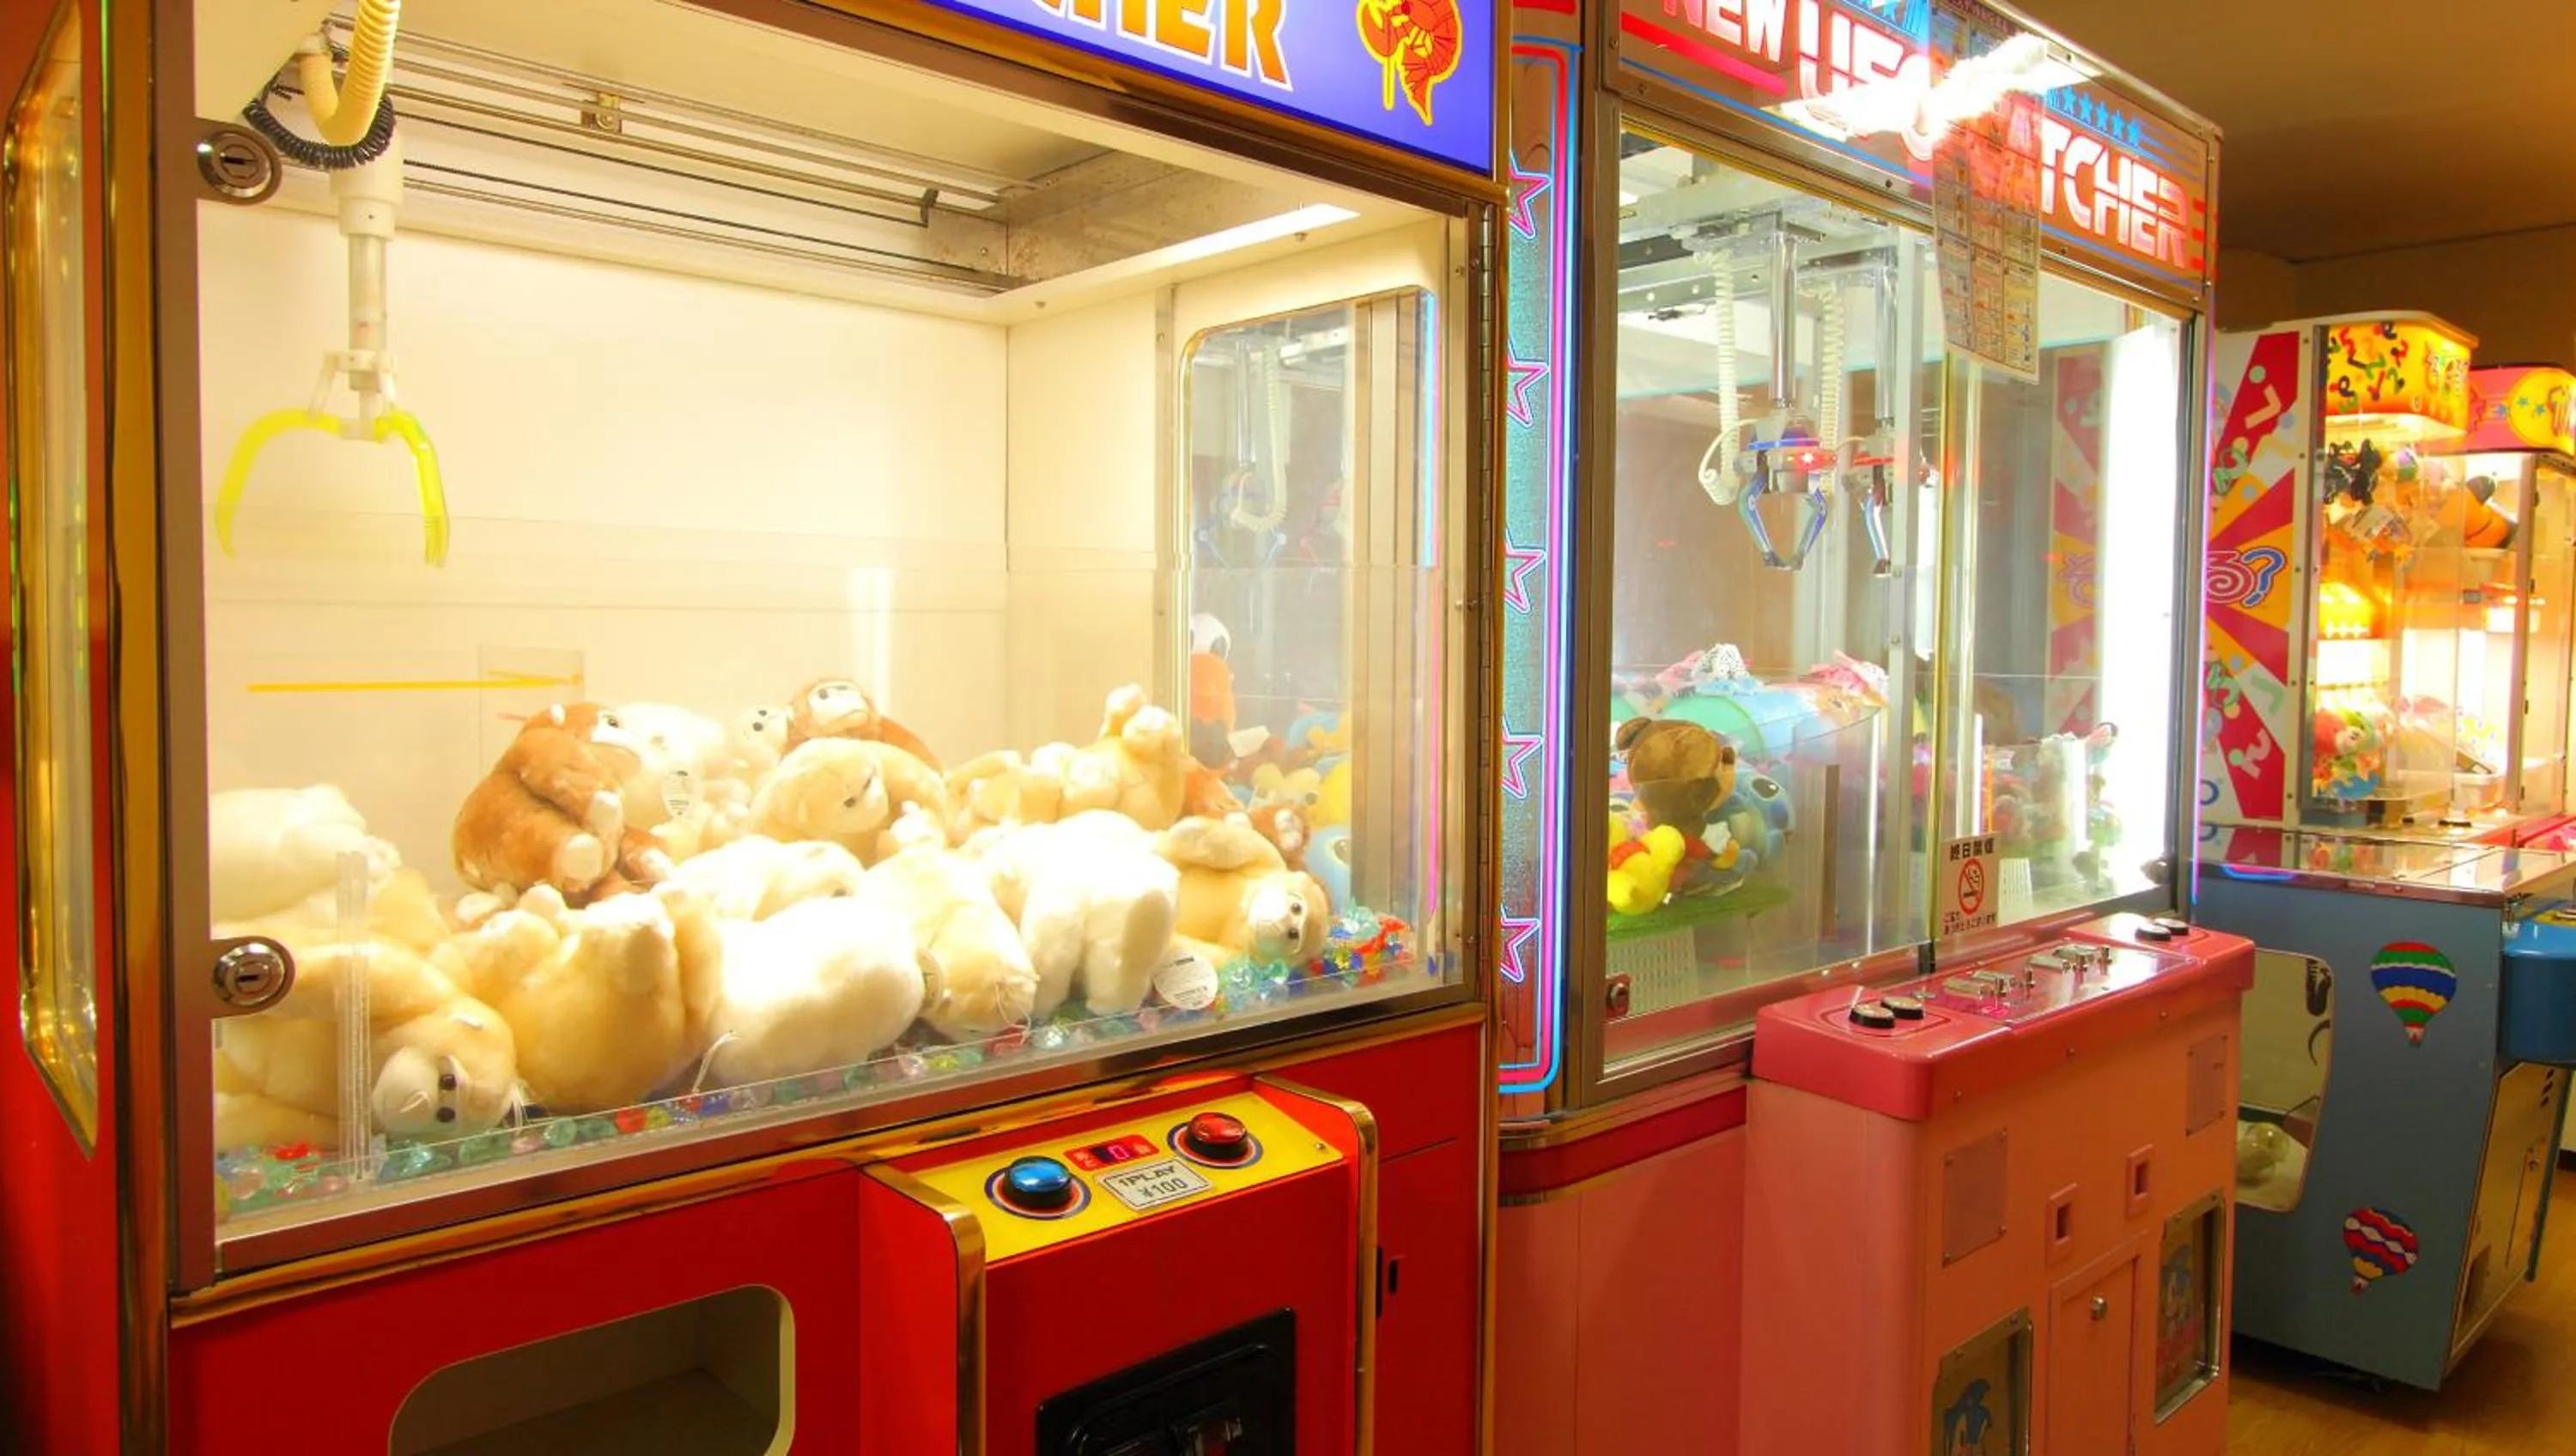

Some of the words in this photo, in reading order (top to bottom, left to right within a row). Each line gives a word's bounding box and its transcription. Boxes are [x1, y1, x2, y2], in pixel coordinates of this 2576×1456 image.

[1662, 0, 1787, 64] EW
[1118, 1165, 1177, 1187] 1PLAY
[1138, 1178, 1188, 1198] ¥100
